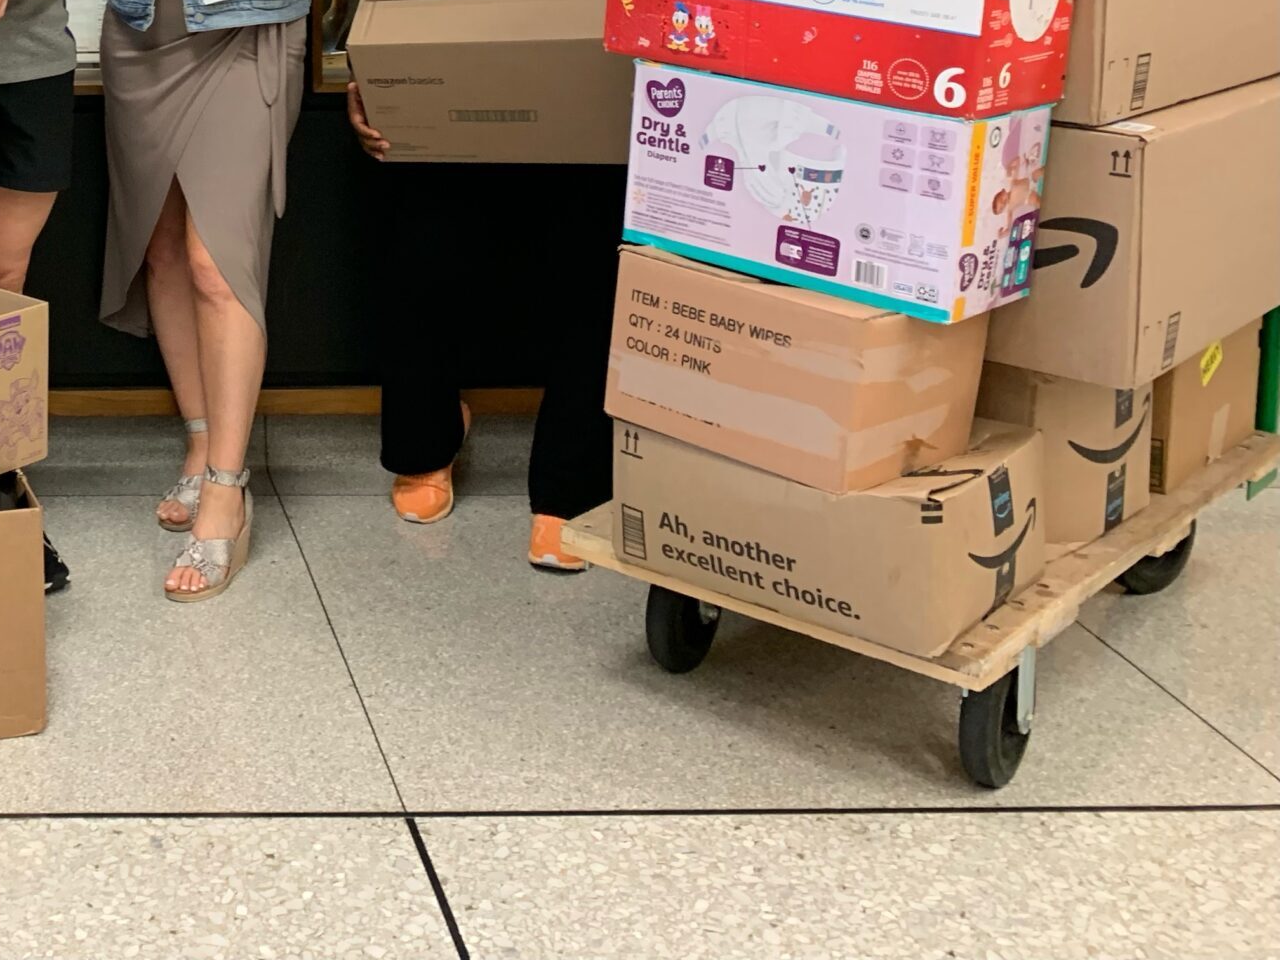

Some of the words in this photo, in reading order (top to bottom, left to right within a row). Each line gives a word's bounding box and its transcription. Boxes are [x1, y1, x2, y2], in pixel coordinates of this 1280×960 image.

[862, 59, 879, 71] 116
[998, 62, 1012, 89] 6
[366, 77, 407, 87] amazon
[408, 76, 445, 86] basics
[651, 86, 683, 100] Parent's
[933, 67, 967, 108] 6
[641, 116, 671, 137] Dry
[675, 123, 687, 137] &
[636, 131, 690, 155] Gentle
[647, 150, 677, 163] Diapers
[631, 289, 660, 309] ITEM
[672, 302, 706, 323] BEBE
[709, 313, 745, 334] BABY
[748, 324, 792, 348] WIPES
[628, 313, 654, 332] QTY
[664, 325, 680, 340] 24
[683, 332, 722, 354] UNITS
[626, 336, 670, 361] COLOR
[681, 354, 711, 375] PINK
[658, 511, 696, 545] Ah,
[702, 525, 797, 572] another
[661, 542, 765, 590] excellent
[772, 577, 861, 621] choice.
